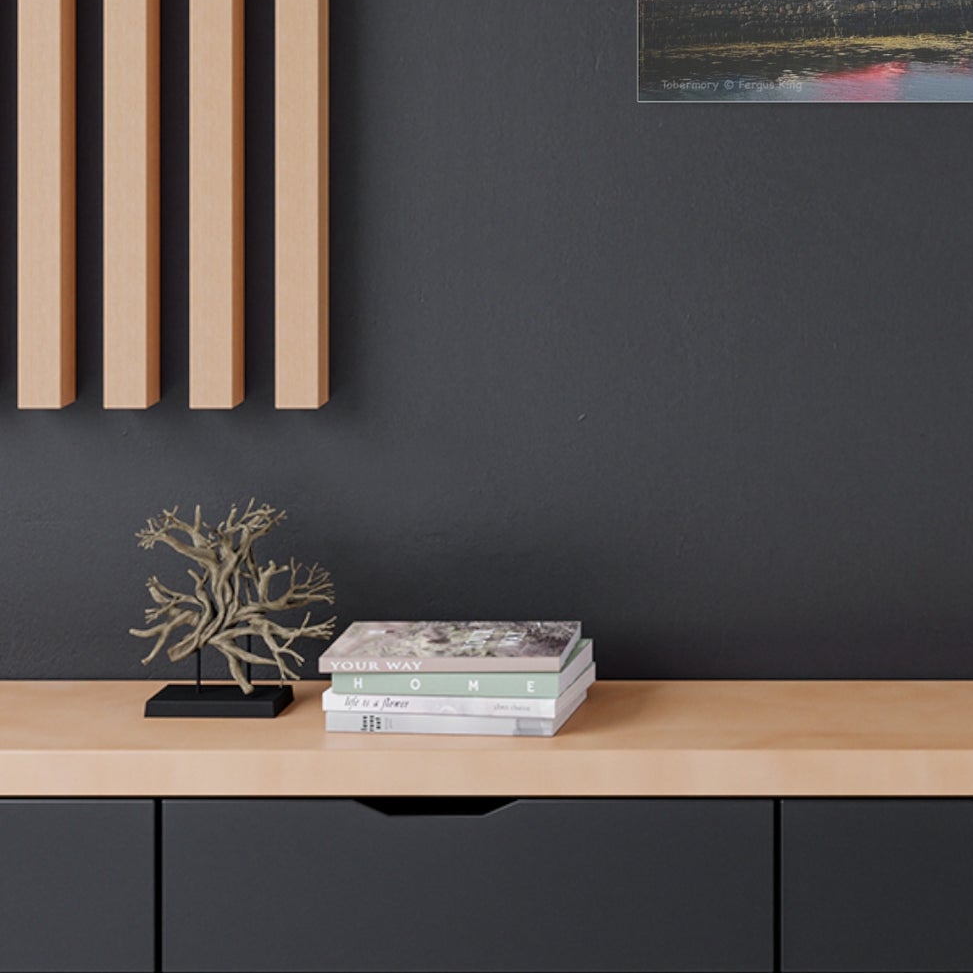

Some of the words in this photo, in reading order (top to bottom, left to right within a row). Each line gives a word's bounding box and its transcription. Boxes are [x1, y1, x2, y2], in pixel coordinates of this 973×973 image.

[661, 79, 719, 92] Tobermory
[738, 79, 775, 92] Fergus
[330, 661, 380, 671] YOUR
[386, 661, 422, 671] WAY
[344, 695, 359, 709] life
[381, 696, 410, 711] flower
